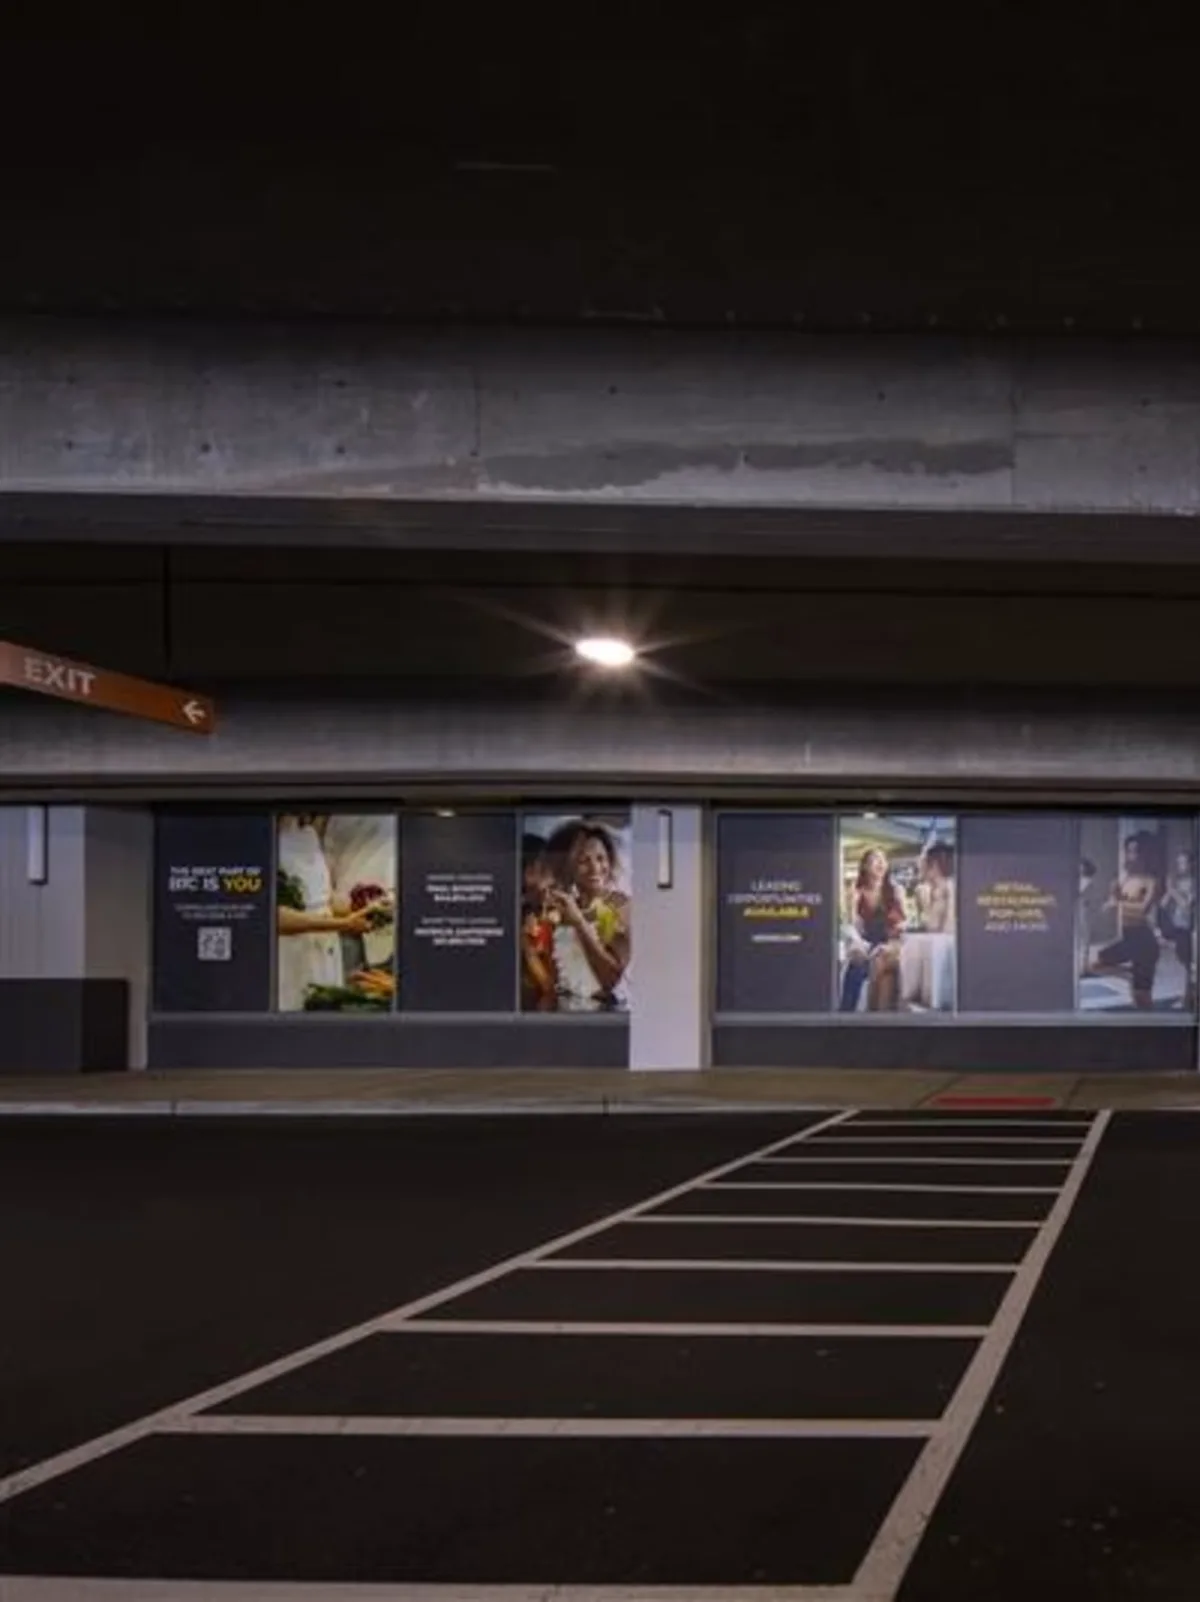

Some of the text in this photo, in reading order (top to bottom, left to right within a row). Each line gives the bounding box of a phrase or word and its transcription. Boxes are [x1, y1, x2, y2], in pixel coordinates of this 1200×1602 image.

[24, 657, 96, 696] EXIT
[203, 877, 220, 892] IS
[222, 877, 263, 893] YOU
